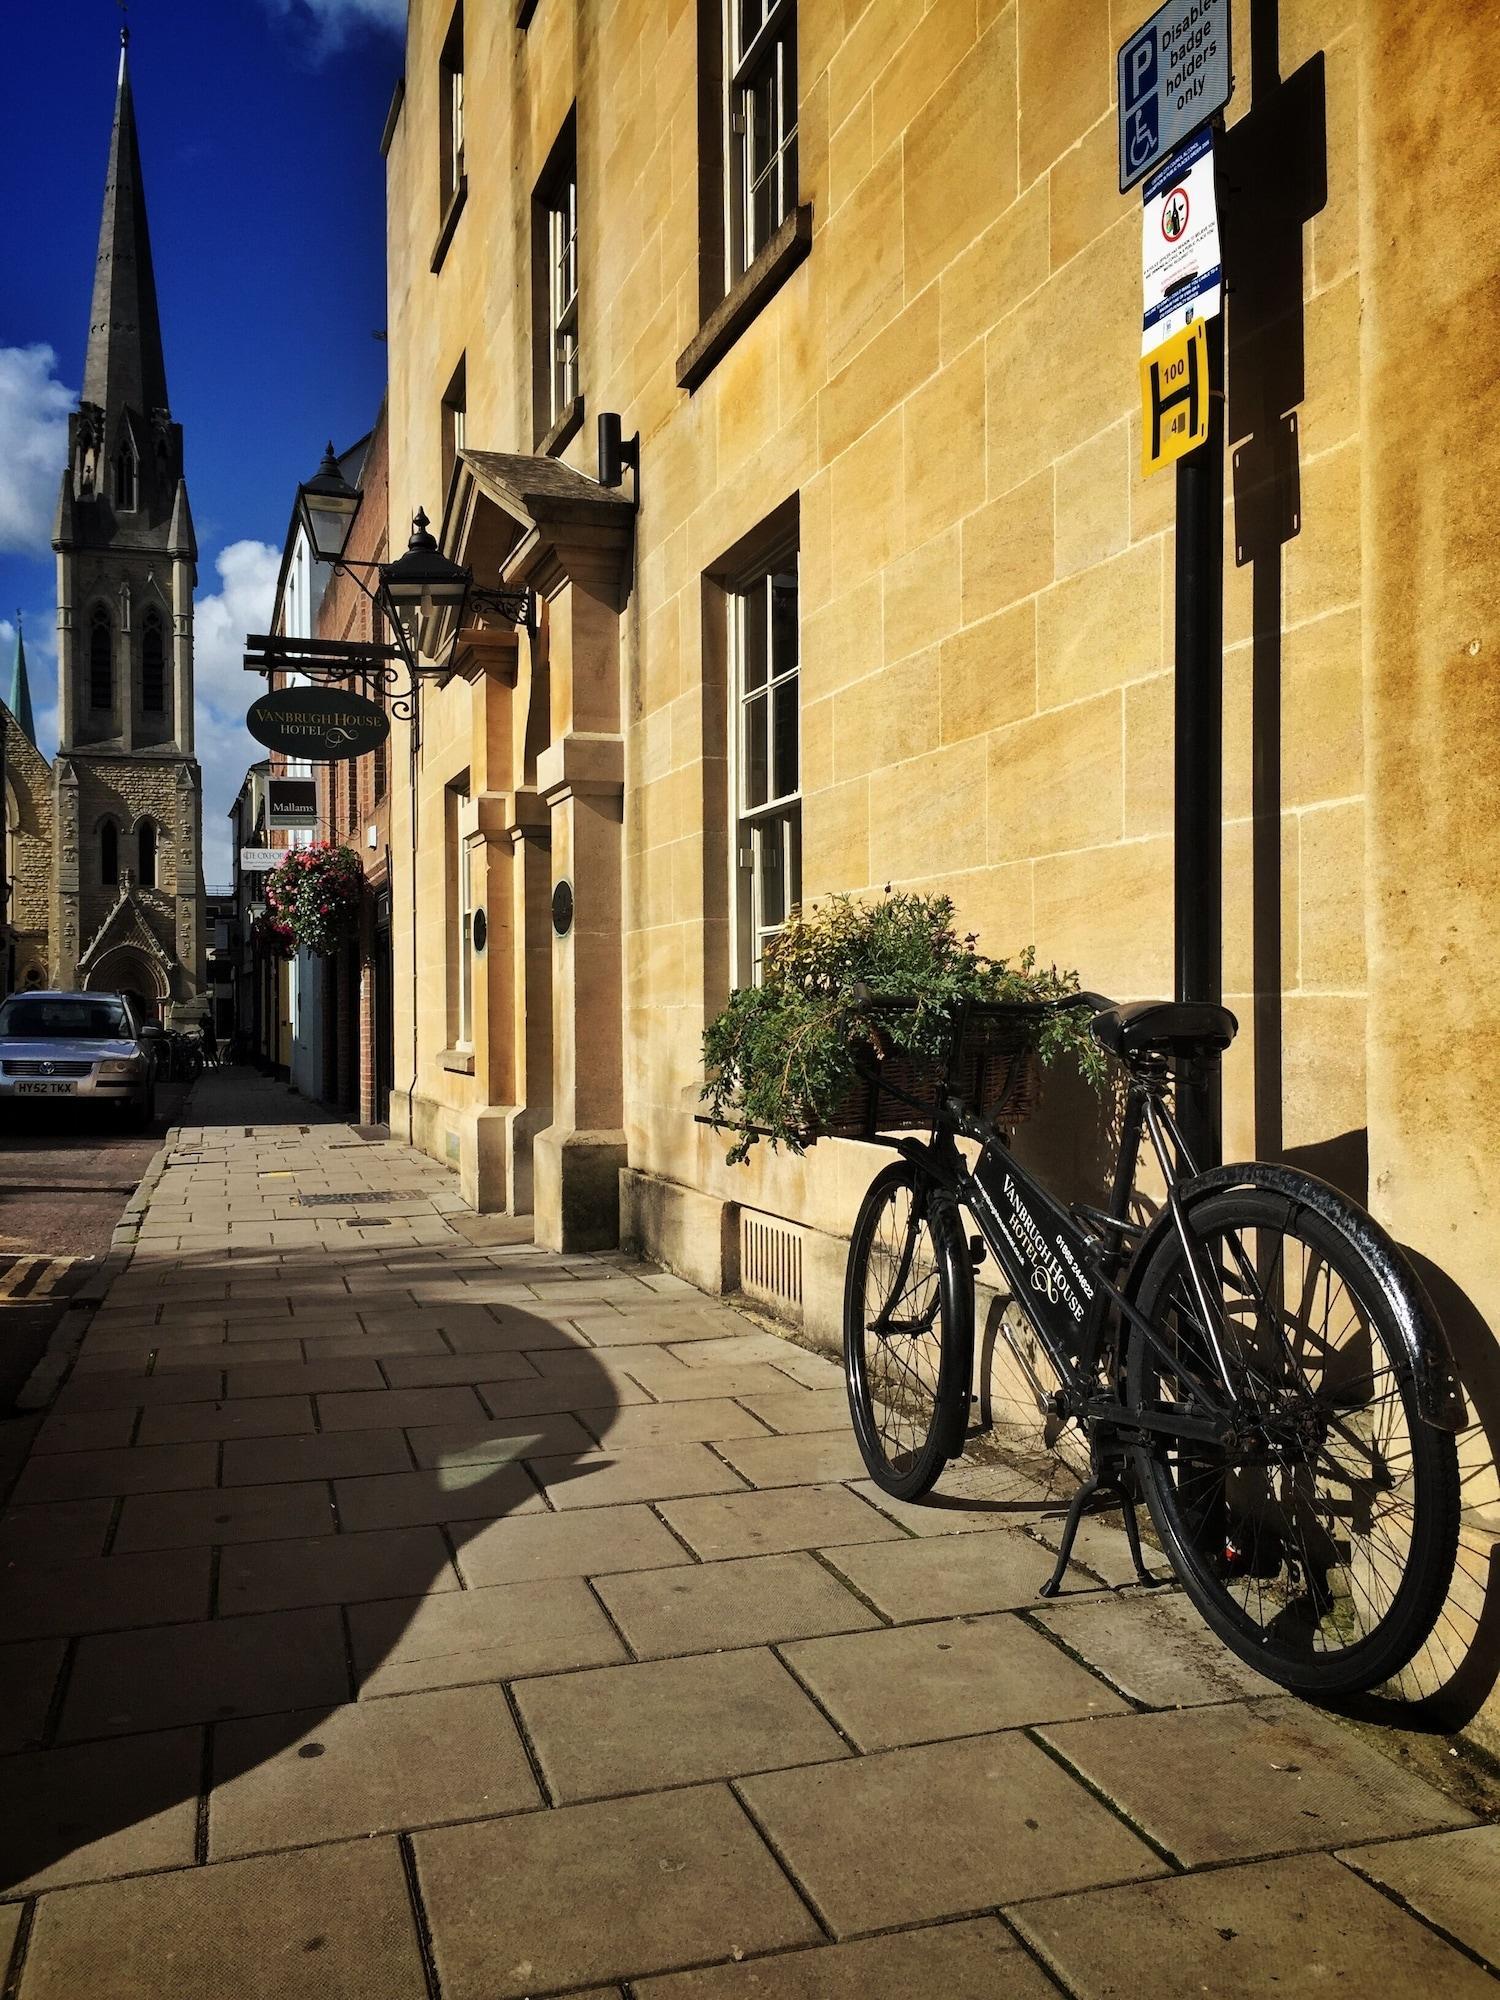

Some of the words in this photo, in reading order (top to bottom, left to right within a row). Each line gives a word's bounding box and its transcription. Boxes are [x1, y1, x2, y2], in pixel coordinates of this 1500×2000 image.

[1162, 0, 1217, 52] Disable
[1171, 21, 1211, 68] badge
[1132, 41, 1152, 99] P
[1167, 40, 1216, 97] holders
[1177, 74, 1205, 110] only
[1164, 359, 1185, 384] 100
[1150, 336, 1199, 461] H
[256, 708, 331, 726] VANBRUGH
[333, 712, 382, 728] HOUSE
[281, 724, 326, 737] HOTEL
[273, 802, 314, 812] Mallams
[19, 1083, 48, 1093] HY52
[50, 1083, 72, 1093] TKX
[1003, 1173, 1052, 1264] VANBRUGH
[1048, 1256, 1085, 1322] HOUSE
[1009, 1213, 1038, 1267] HOTEL
